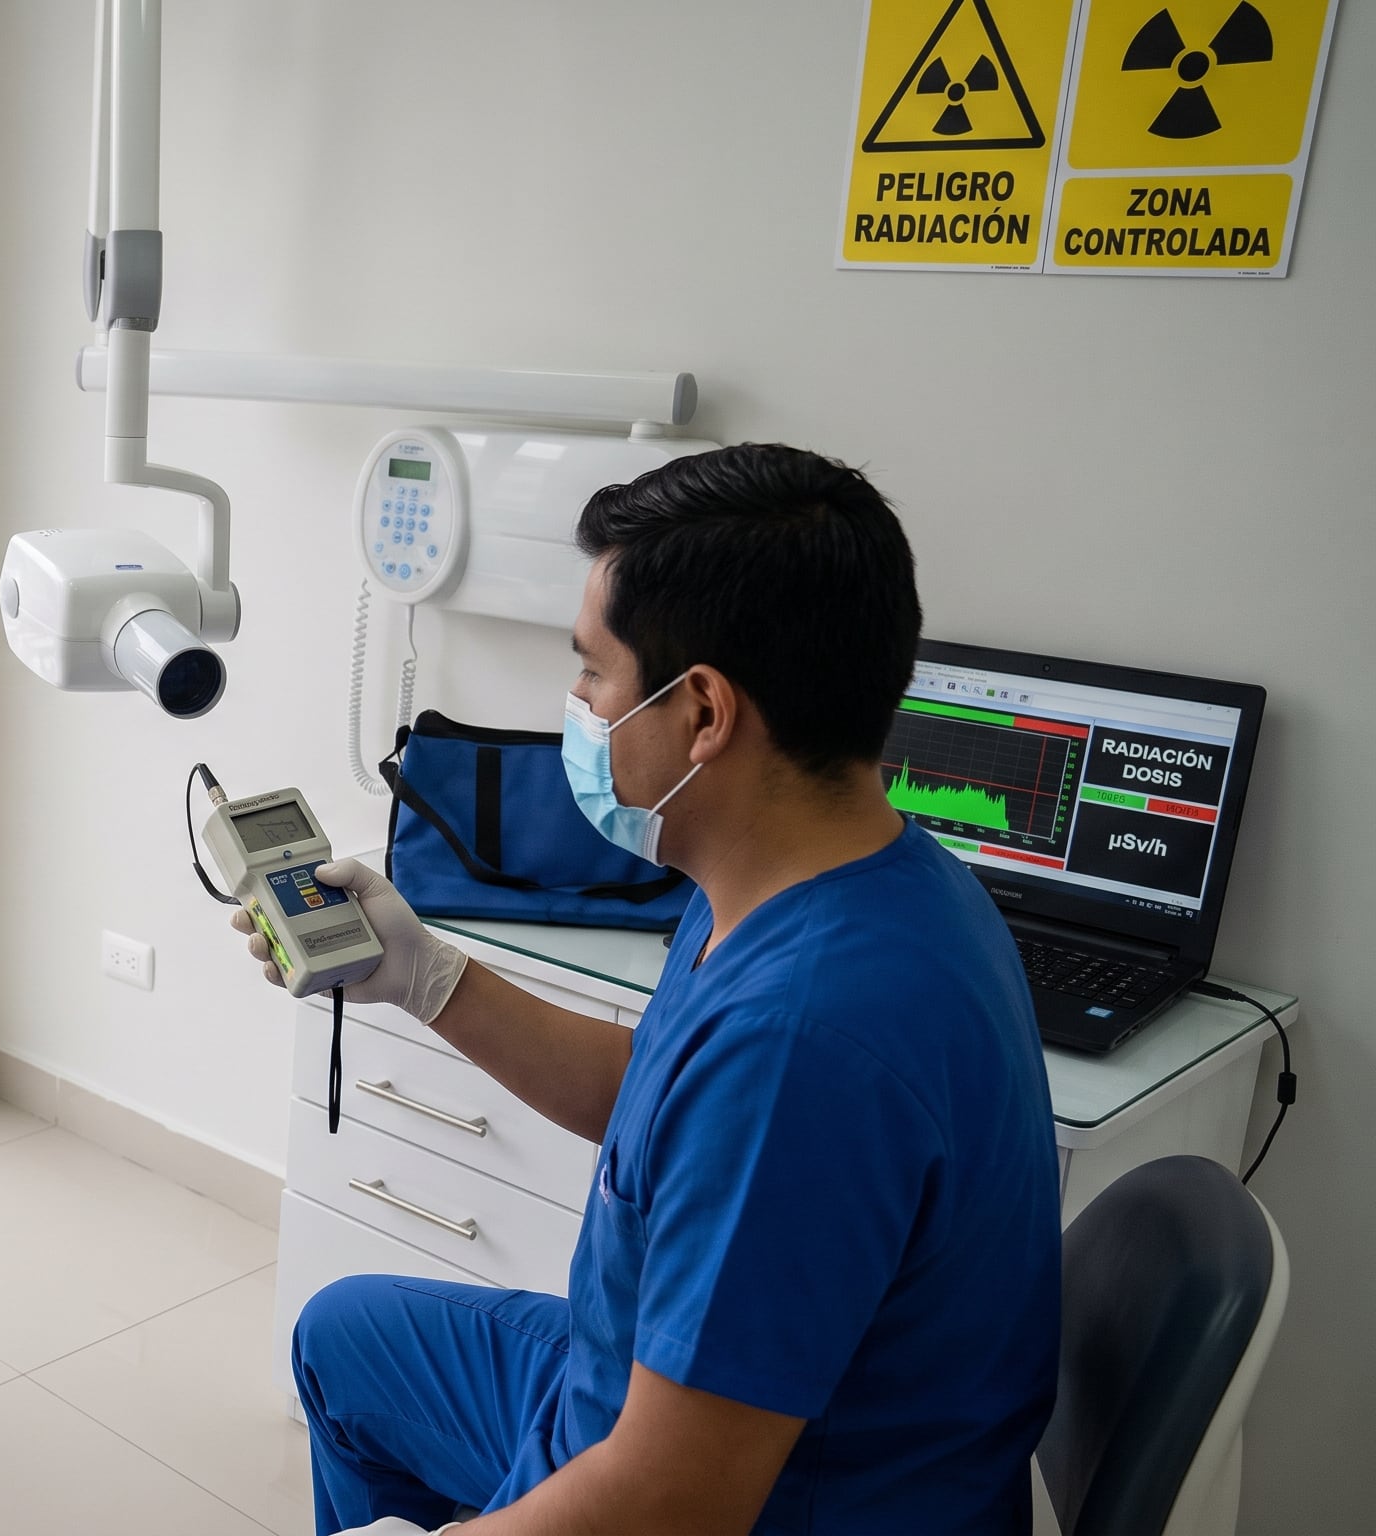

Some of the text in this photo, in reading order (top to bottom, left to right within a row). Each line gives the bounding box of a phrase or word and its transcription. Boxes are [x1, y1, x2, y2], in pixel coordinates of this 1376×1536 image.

[876, 170, 1015, 202] PELIGRO
[1126, 187, 1212, 217] ZONA
[854, 206, 1030, 244] RADIACIÓN
[1064, 227, 1271, 257] CONTROLADA
[1101, 739, 1213, 770] RADIACIÓN
[1122, 763, 1183, 788] DOSIS
[1108, 833, 1167, 857] µSv/h
